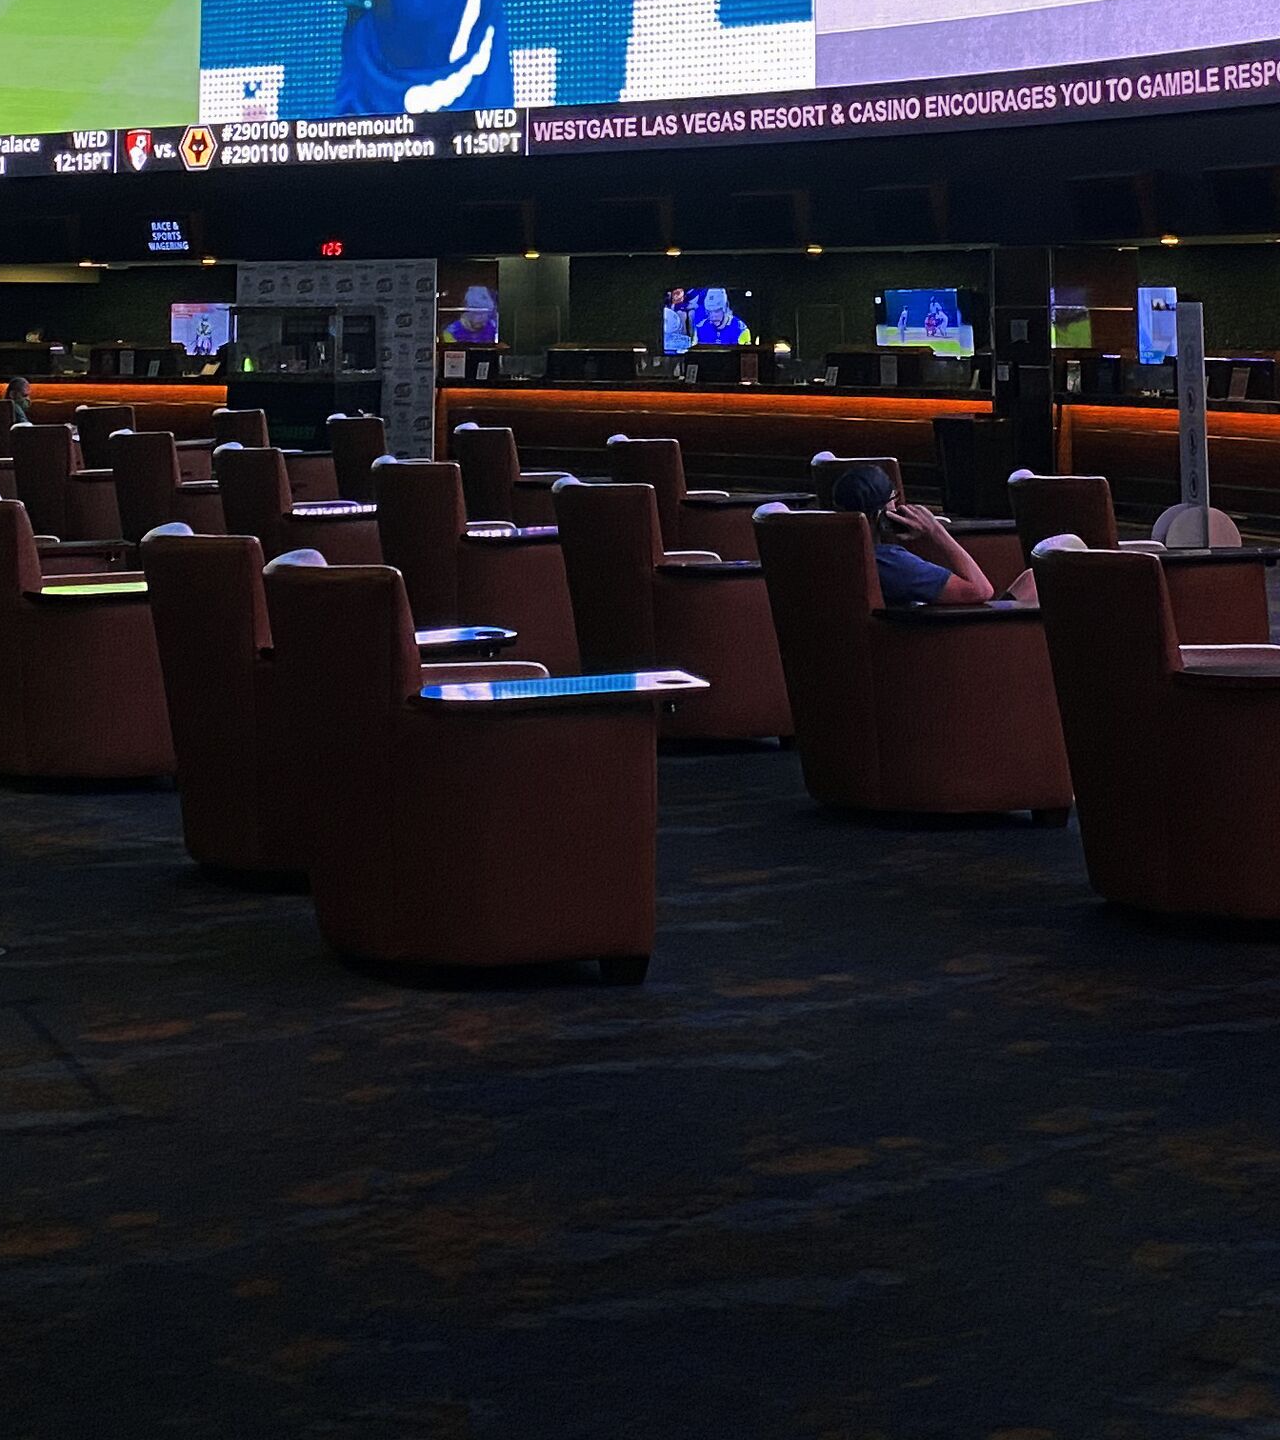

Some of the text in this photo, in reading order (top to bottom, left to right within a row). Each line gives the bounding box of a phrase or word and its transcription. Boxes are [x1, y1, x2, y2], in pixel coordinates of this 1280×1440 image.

[534, 118, 637, 141] WESTGATE
[641, 115, 678, 136] LAS
[681, 111, 746, 134] VEGAS
[750, 105, 827, 130] RESORT
[831, 104, 845, 124] &
[848, 96, 920, 123] CASINO
[925, 86, 1056, 117] ENCOURAGES
[1061, 81, 1102, 106] YOU
[1106, 78, 1133, 102] TO
[1137, 67, 1220, 100] GAMBLE
[222, 115, 414, 142] #290109 Bournemouth
[475, 109, 517, 129] WED
[73, 131, 107, 149] WED
[452, 135, 522, 155] 11:50PT
[54, 152, 111, 172] 12:15PT
[222, 139, 435, 165] #290110 Wolverhampton
[151, 222, 171, 231] RACE
[152, 231, 181, 241] SPORTS
[148, 241, 189, 250] WAGERING
